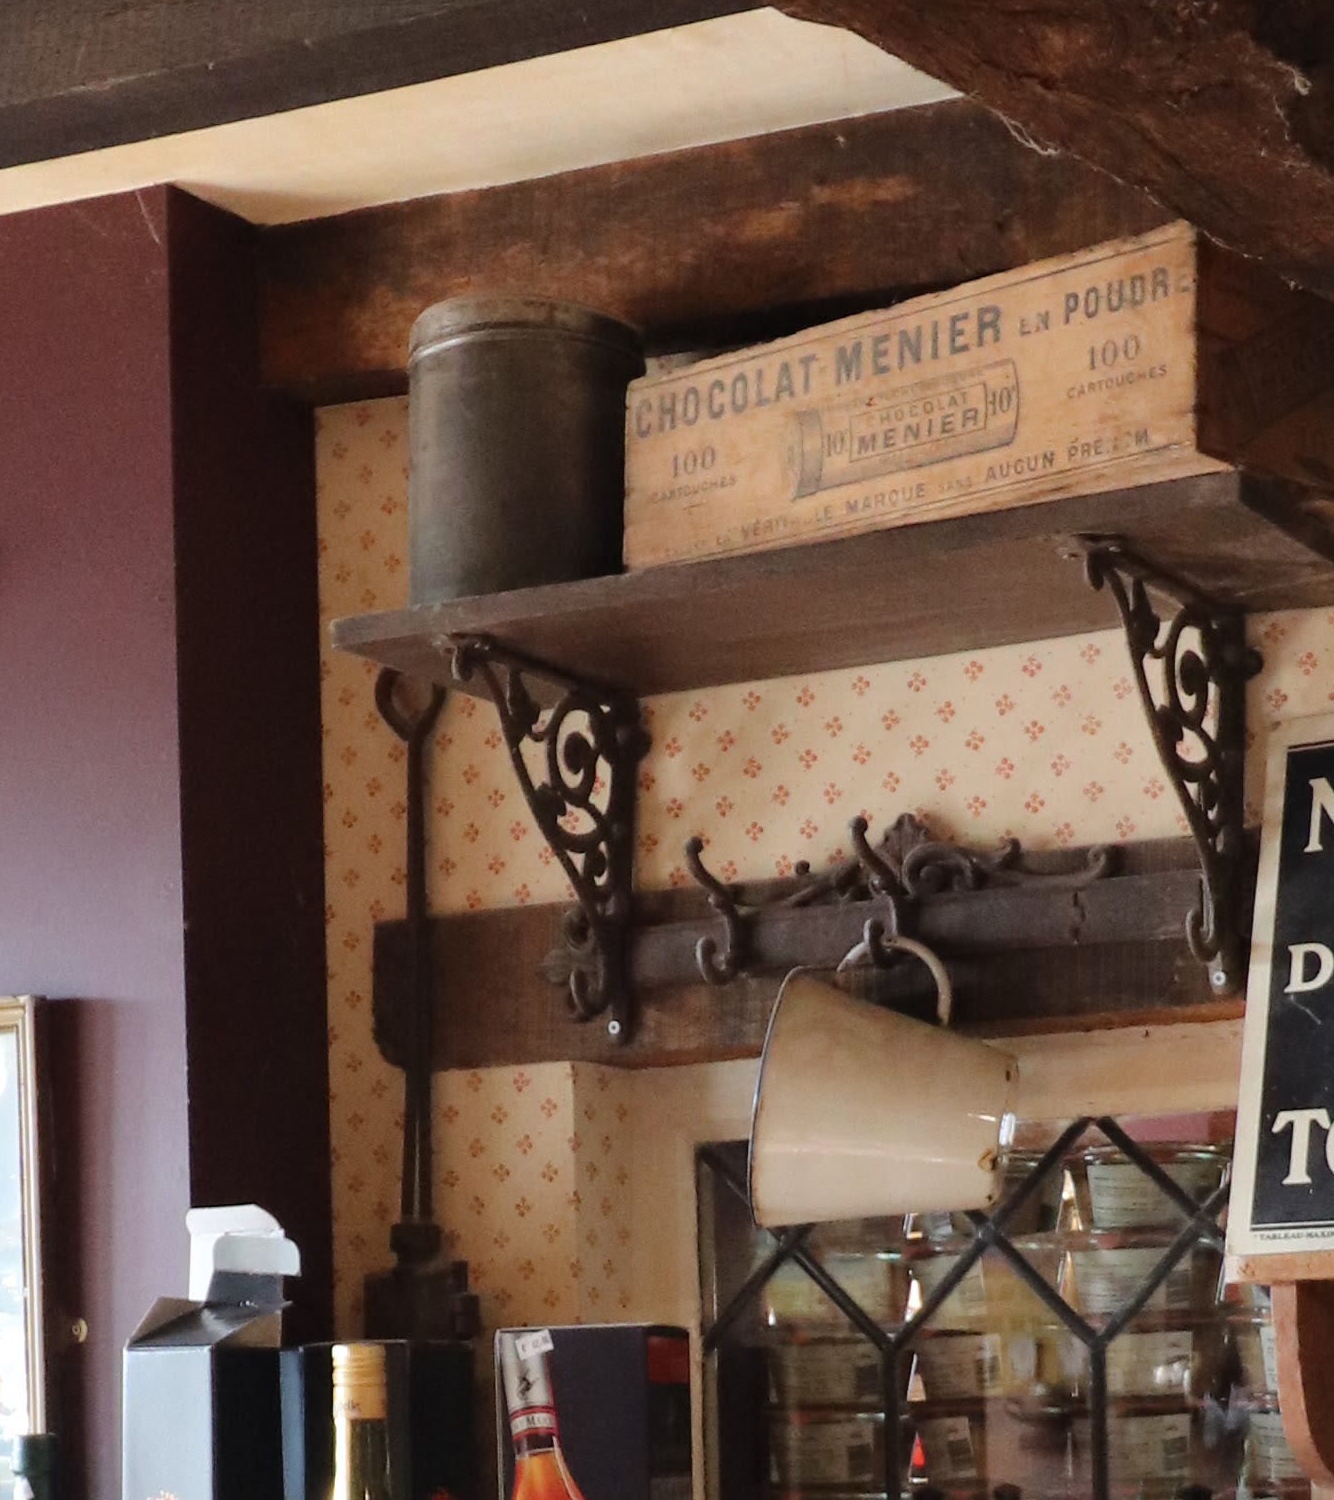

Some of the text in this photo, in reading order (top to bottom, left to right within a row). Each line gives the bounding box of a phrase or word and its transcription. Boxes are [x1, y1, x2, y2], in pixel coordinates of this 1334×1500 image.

[1088, 334, 1141, 371] 100
[635, 354, 818, 439] CHOCOLAT
[834, 305, 1002, 385] MENIER
[1067, 363, 1167, 400] CARTOUCHES
[856, 406, 980, 456] MENIER
[671, 446, 716, 478] 100
[844, 483, 926, 513] MARQUE
